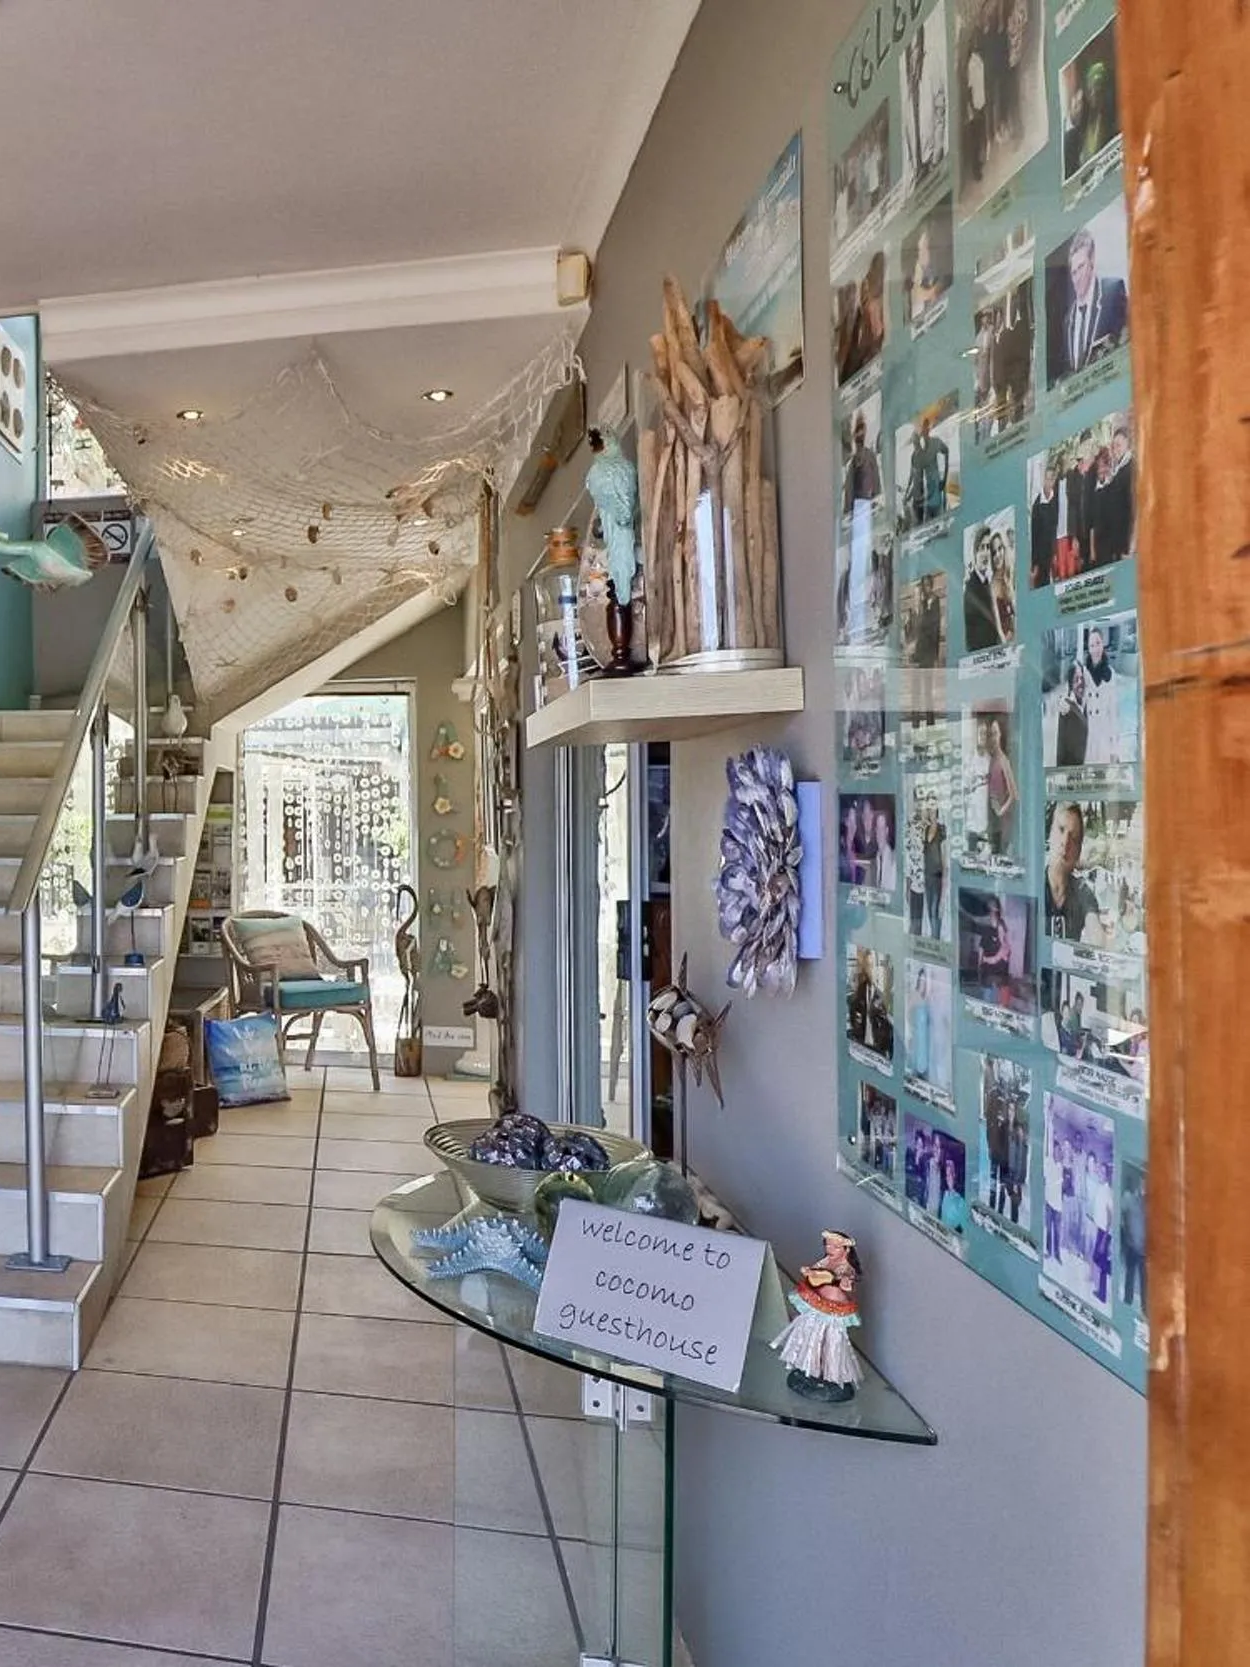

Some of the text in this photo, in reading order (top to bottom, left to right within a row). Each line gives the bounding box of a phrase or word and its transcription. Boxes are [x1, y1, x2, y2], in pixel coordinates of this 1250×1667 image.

[581, 1217, 731, 1269] welcome to
[595, 1270, 695, 1311] cocomo
[558, 1303, 718, 1365] guesthouse
